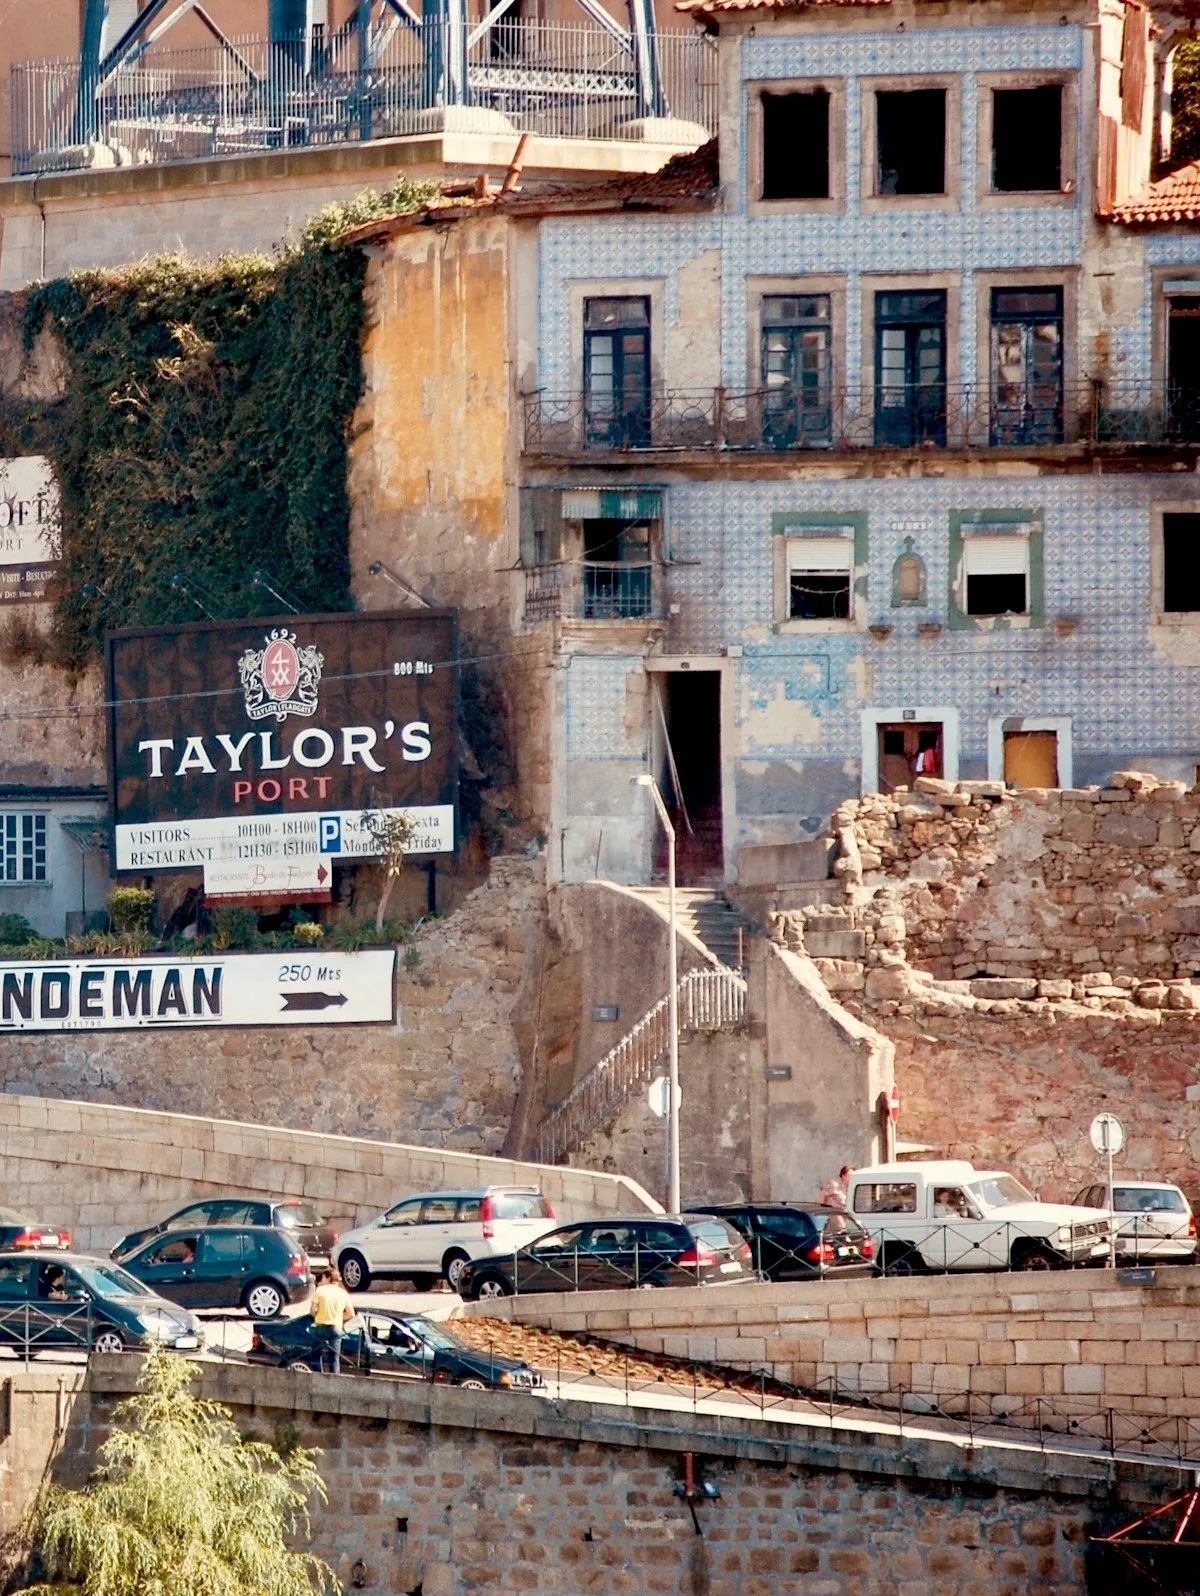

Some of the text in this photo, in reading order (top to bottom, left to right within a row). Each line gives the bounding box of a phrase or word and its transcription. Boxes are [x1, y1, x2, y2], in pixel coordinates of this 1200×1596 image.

[264, 628, 297, 645] 1692
[393, 661, 413, 676] 800
[251, 703, 277, 717] TAYLOR
[138, 720, 432, 778] TAYLOR'S
[234, 776, 332, 803] PORT
[237, 823, 272, 838] 10H00
[282, 820, 317, 836] 18H00
[238, 843, 272, 859] 12H30
[283, 841, 318, 858] 15H00
[278, 965, 341, 982] 250 Mts
